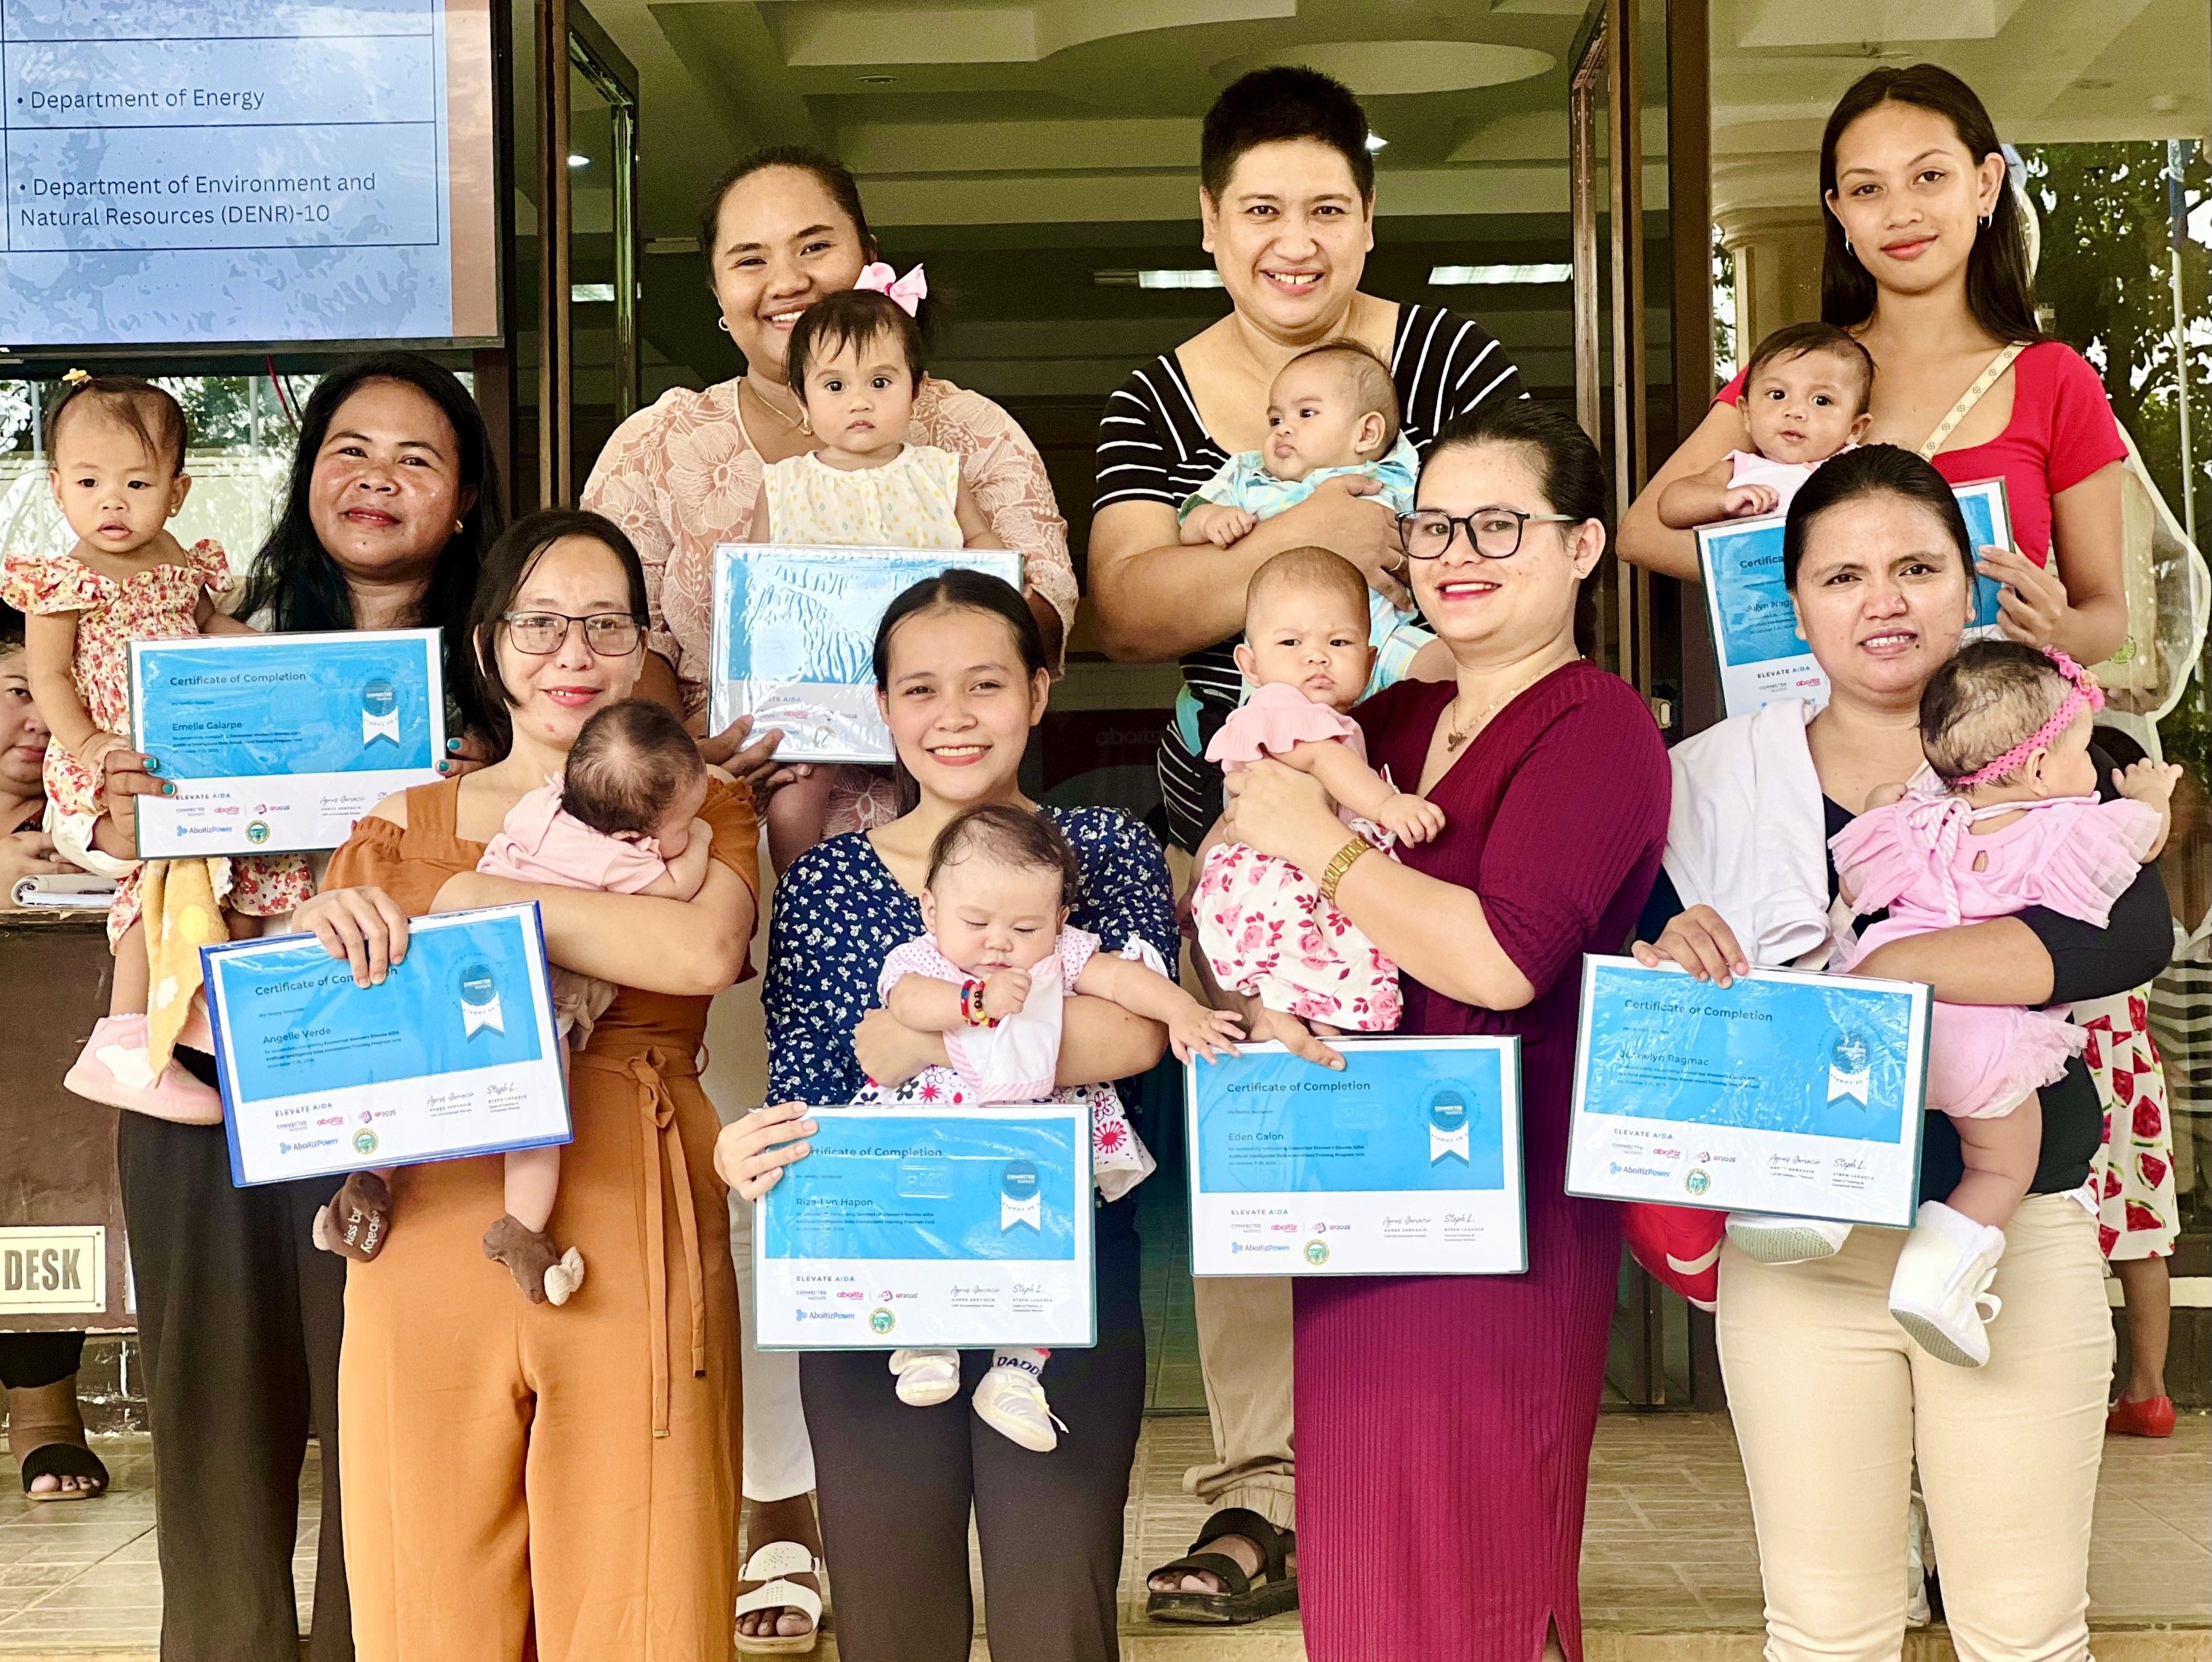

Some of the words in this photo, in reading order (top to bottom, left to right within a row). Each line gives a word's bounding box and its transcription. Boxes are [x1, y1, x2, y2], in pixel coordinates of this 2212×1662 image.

[31, 91, 159, 113] Department
[166, 89, 187, 107] of
[194, 89, 264, 110] Energy
[34, 178, 161, 200] Department
[168, 176, 189, 194] of
[196, 176, 331, 193] Environment
[337, 173, 375, 191] and
[21, 208, 99, 226] Natural
[107, 207, 213, 224] Resources
[221, 205, 330, 225] (DENR)-10
[1740, 556, 1784, 568] Certifica
[170, 676, 227, 685] Certificate
[230, 674, 241, 683] of
[244, 673, 306, 683] Completion
[1757, 669, 1790, 679] ELEVATE
[255, 980, 315, 996] Certificate
[318, 976, 328, 986] of
[1625, 1000, 1685, 1013] Certificate
[1704, 1006, 1773, 1022] Completion
[302, 1027, 331, 1039] Verde
[1227, 1082, 1286, 1092] Certificate
[1290, 1082, 1301, 1091] of
[1304, 1081, 1371, 1092] Completion
[275, 1106, 310, 1117] ELEVATE
[1614, 1129, 1650, 1137] ELEVATE
[293, 1138, 338, 1151] AboitizPower
[810, 1147, 856, 1156] rtificate
[860, 1147, 871, 1156] of
[874, 1148, 942, 1158] Completion
[1624, 1166, 1671, 1177] AboitizPower
[841, 1198, 873, 1207] Hapon
[4, 1248, 81, 1291] DESK
[997, 1357, 1039, 1374] DADD
